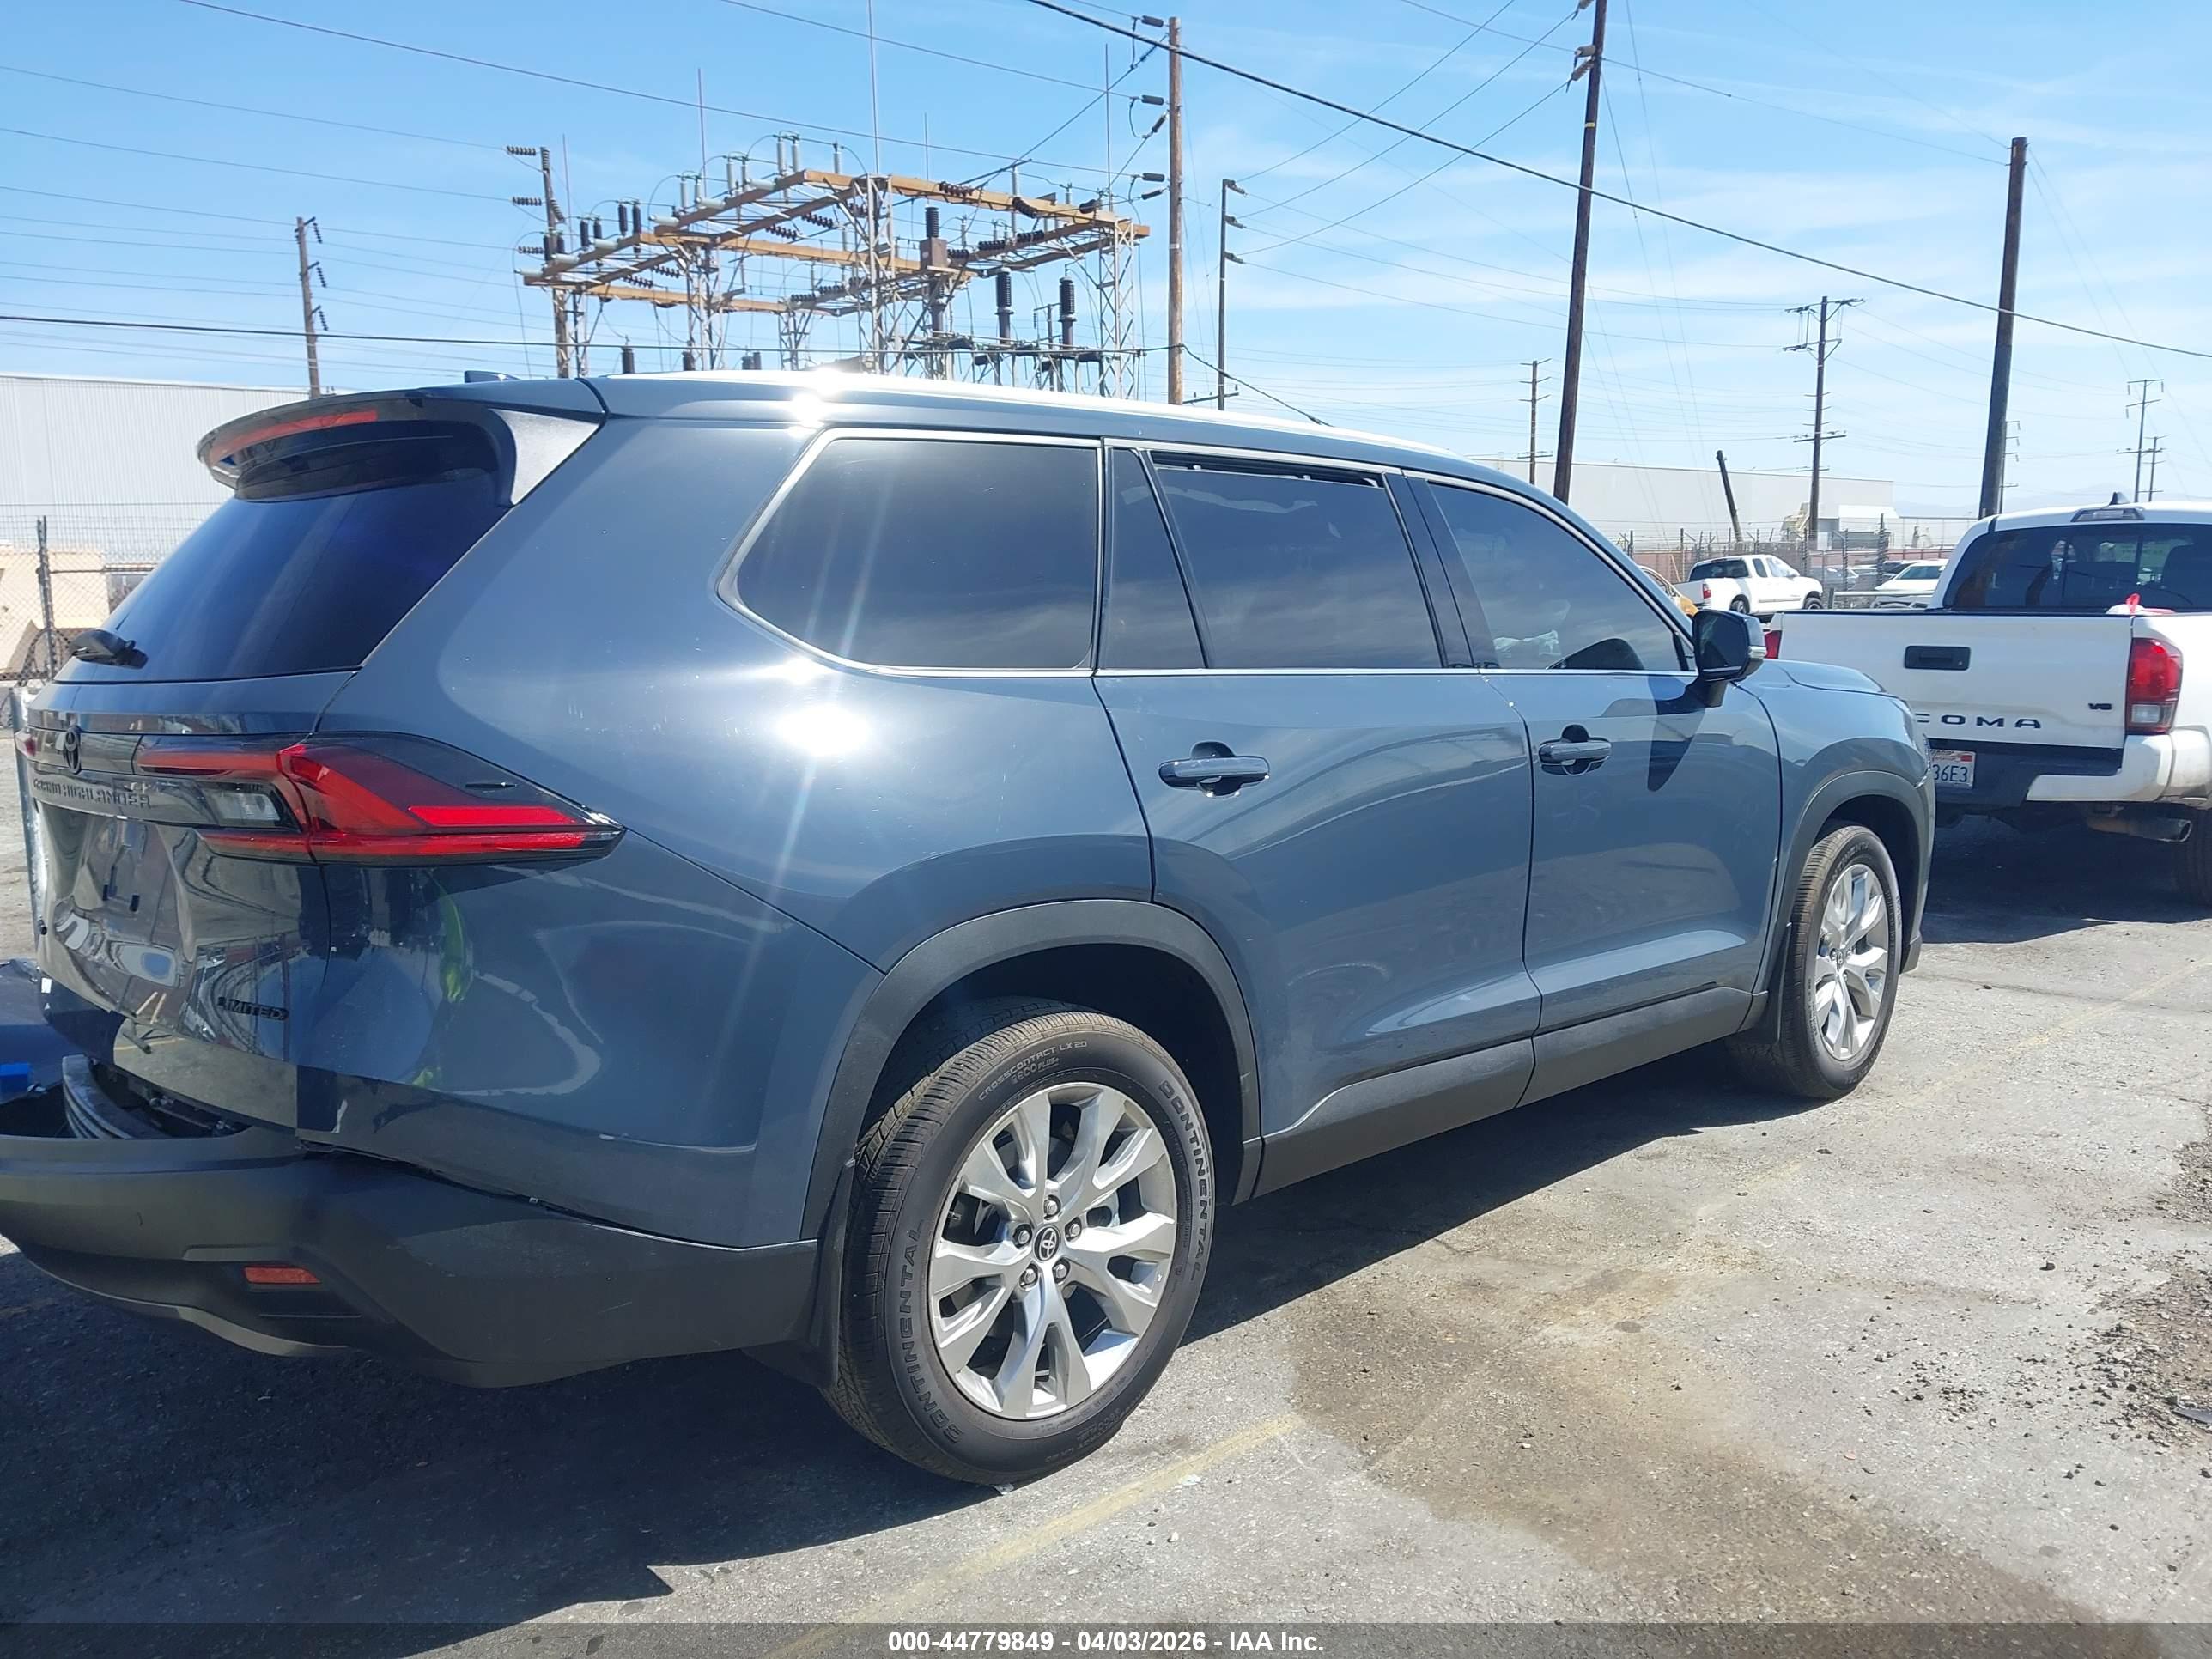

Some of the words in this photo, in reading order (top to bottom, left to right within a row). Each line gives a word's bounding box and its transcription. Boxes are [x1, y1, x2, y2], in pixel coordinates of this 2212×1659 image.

[2087, 702, 2112, 711] V6
[1914, 713, 2041, 729] COMA
[63, 783, 151, 809] HIGHLANDER
[217, 996, 289, 1021] LIMITED
[978, 1046, 1057, 1102] CROSSCONTACT
[899, 1218, 964, 1443] CONTINENTAL
